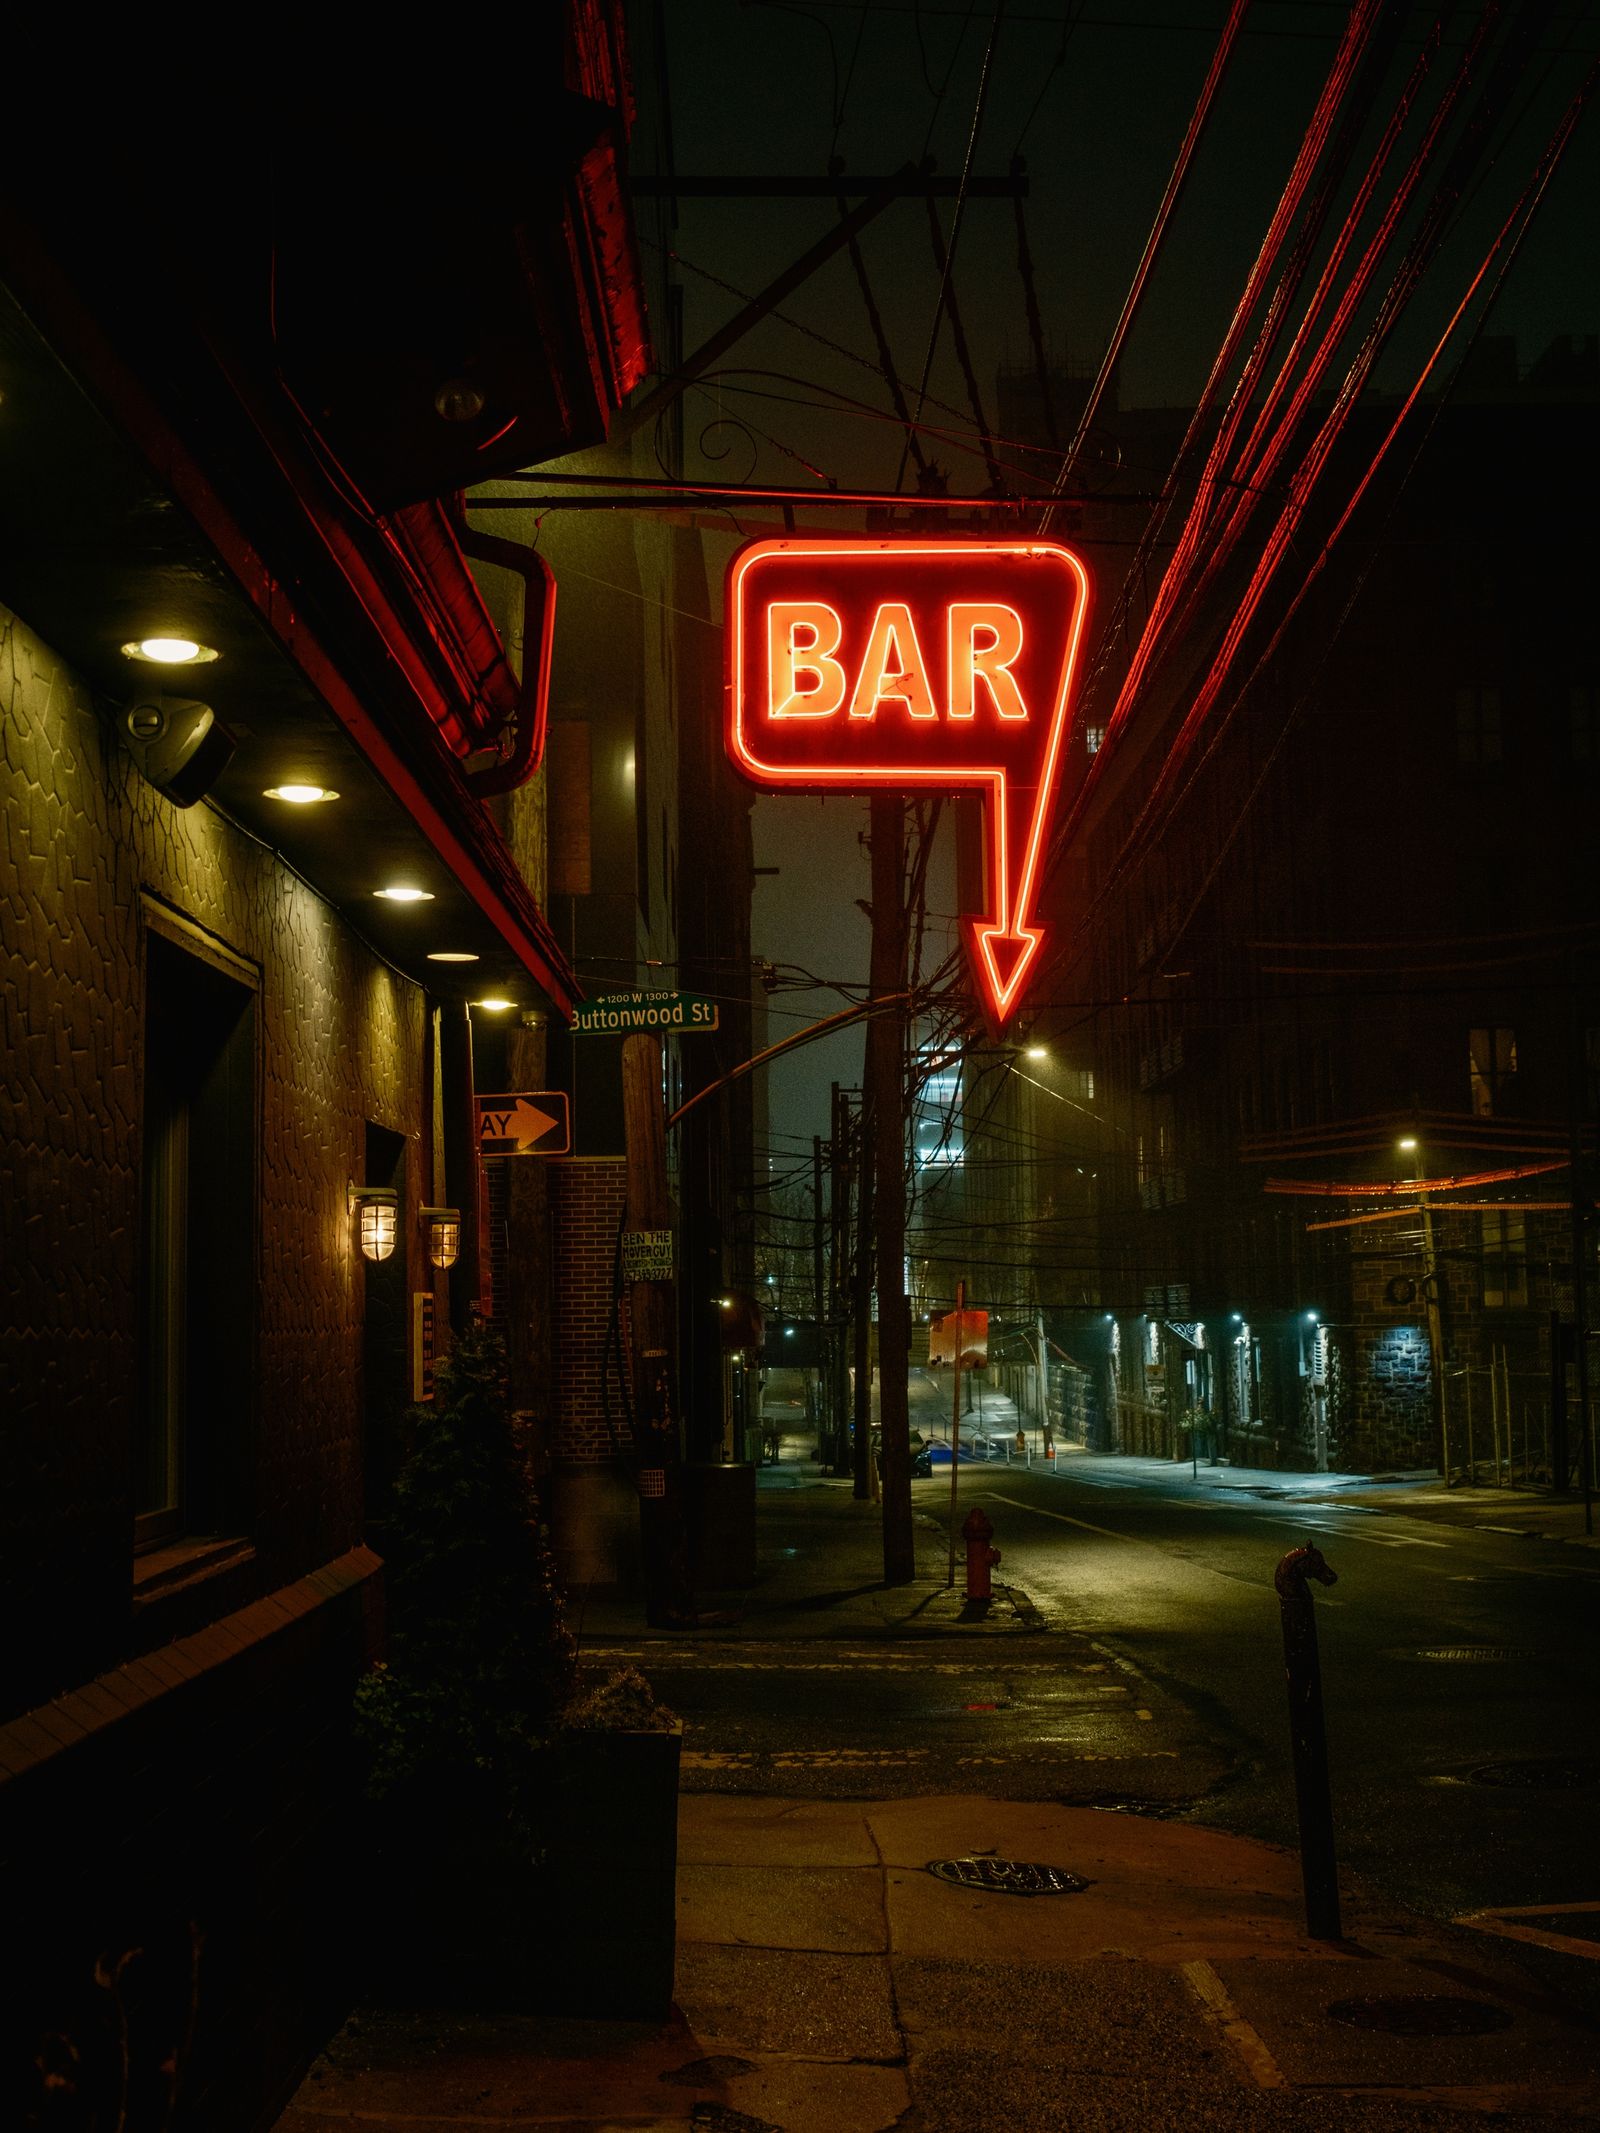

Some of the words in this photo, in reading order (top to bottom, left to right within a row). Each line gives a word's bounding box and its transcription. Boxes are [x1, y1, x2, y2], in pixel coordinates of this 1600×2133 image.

[768, 602, 1029, 721] BAR
[607, 994, 629, 1004] 1200
[632, 992, 642, 1003] W
[646, 992, 669, 1001] 1300
[569, 1003, 683, 1031] Buttonwood
[692, 1003, 710, 1022] St
[623, 1233, 645, 1245] BEN
[648, 1232, 670, 1243] THE
[653, 1244, 671, 1258] GUY
